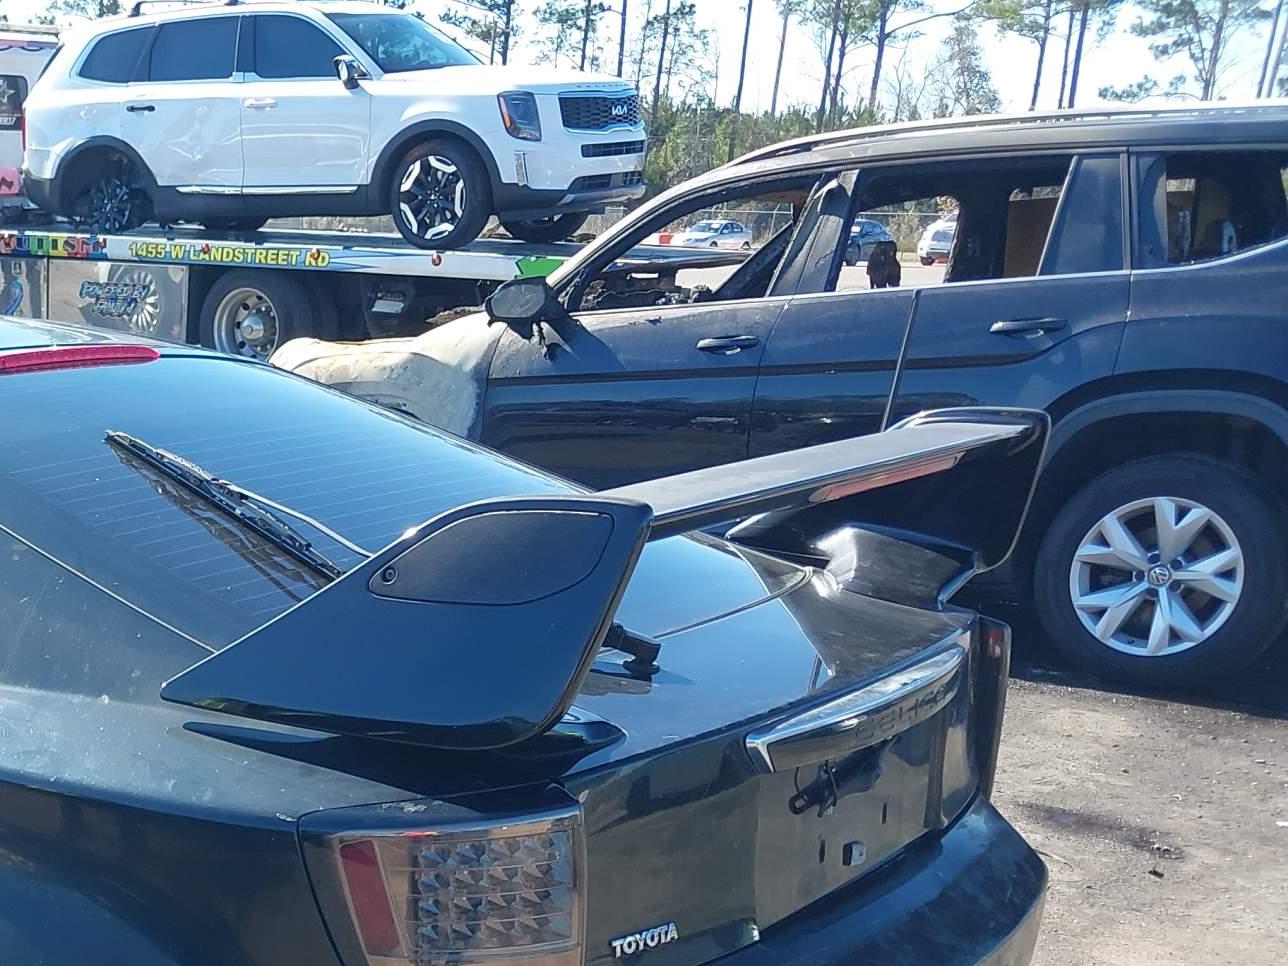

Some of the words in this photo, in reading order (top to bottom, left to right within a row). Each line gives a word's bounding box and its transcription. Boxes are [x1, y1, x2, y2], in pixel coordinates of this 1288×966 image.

[612, 105, 628, 116] KIA
[129, 242, 166, 259] 1455
[171, 245, 186, 260] W
[189, 246, 300, 266] LANDSTREET
[305, 250, 329, 267] RD
[611, 922, 679, 959] TOYOTA
